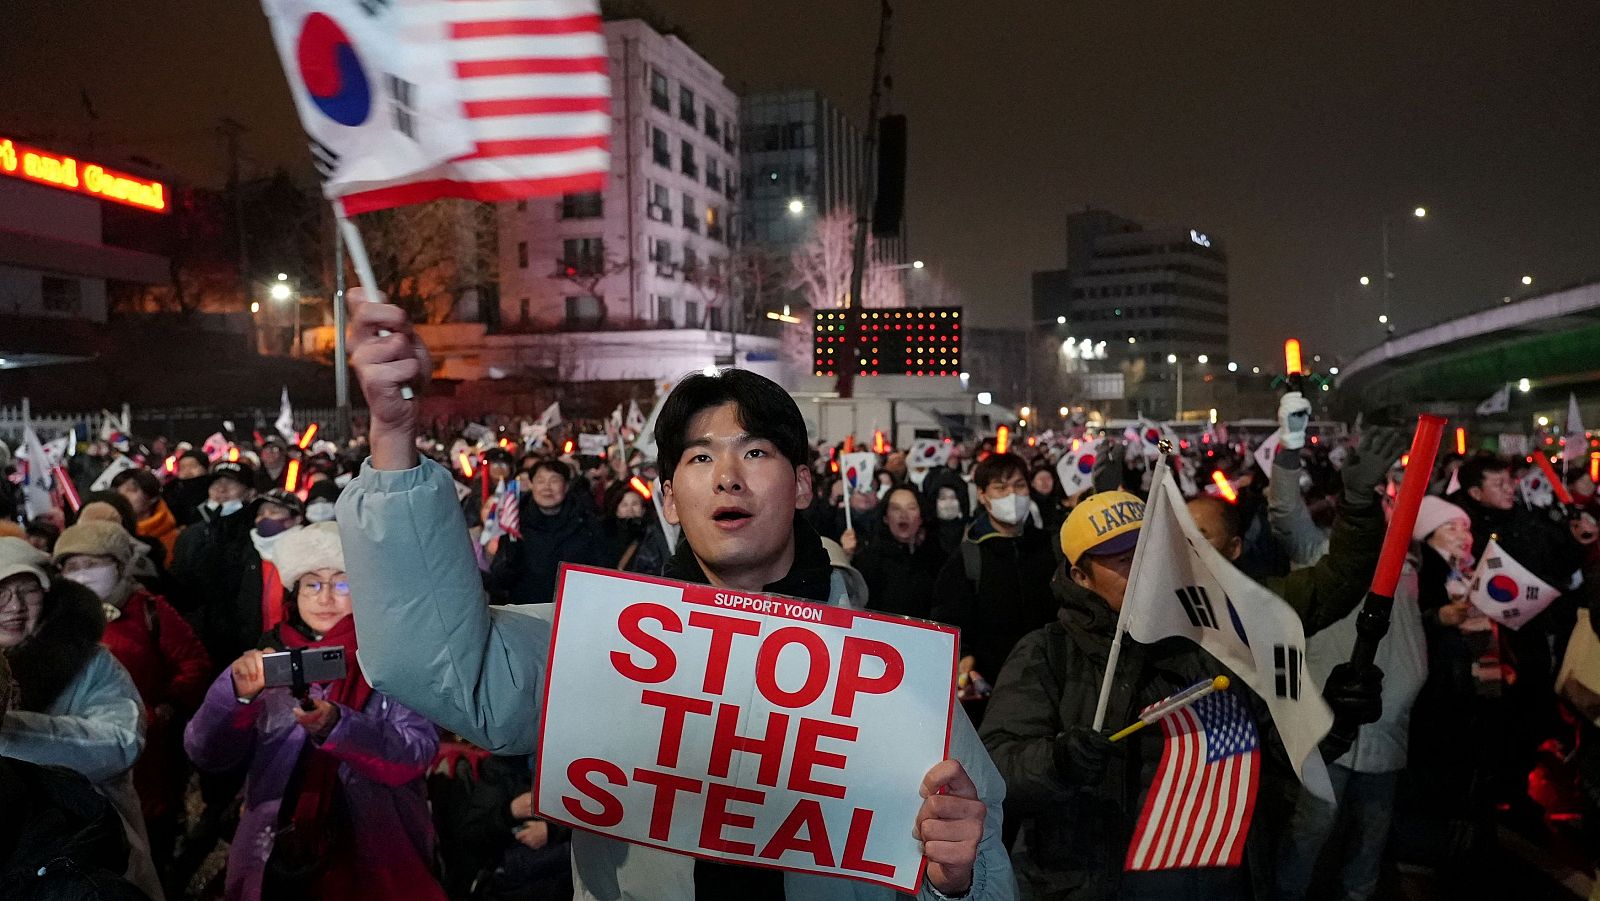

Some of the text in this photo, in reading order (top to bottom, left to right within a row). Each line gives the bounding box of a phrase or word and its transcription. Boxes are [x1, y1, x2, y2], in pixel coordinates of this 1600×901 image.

[24, 153, 79, 187] and
[609, 602, 905, 718] STOP
[714, 593, 823, 621] SUPPORT YOON
[641, 690, 859, 799] THE
[561, 758, 897, 878] STEAL
